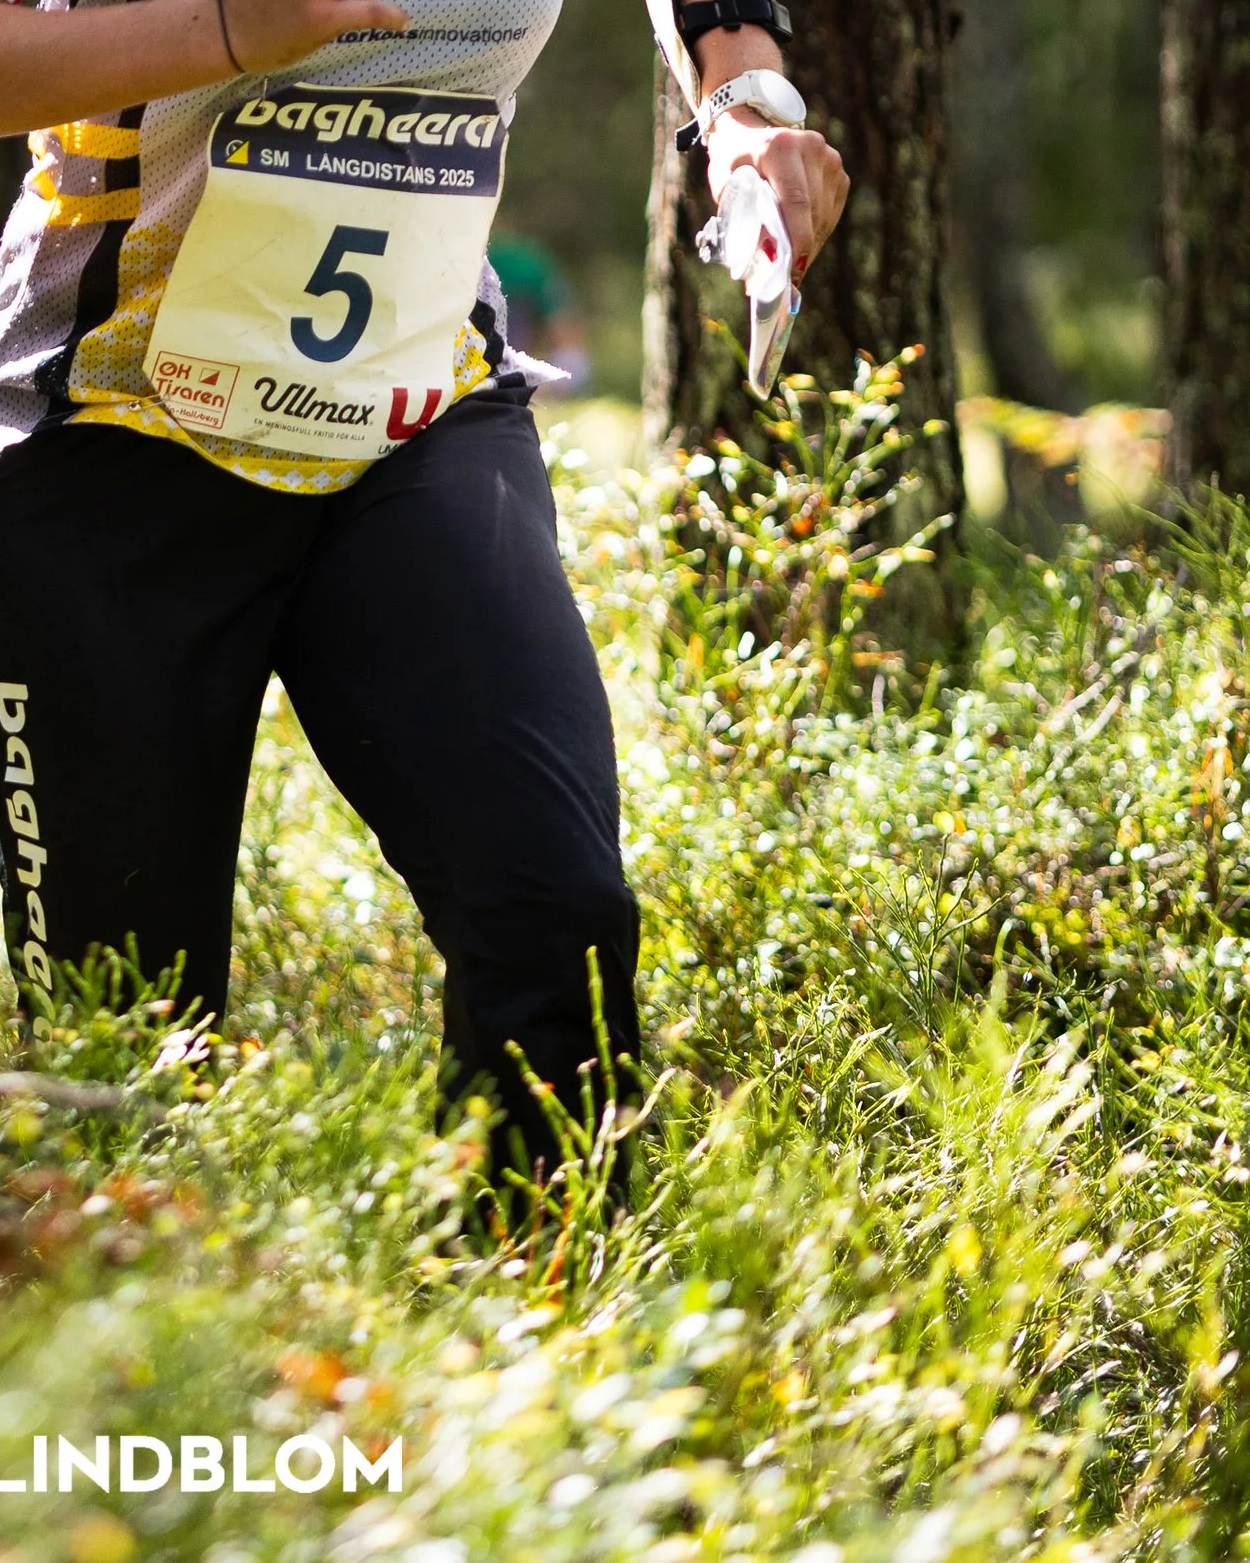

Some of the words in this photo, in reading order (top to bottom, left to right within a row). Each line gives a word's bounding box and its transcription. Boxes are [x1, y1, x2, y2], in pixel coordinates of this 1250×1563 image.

[235, 98, 501, 148] bagheera
[260, 149, 290, 168] SM
[306, 152, 435, 186] LÅNGDISTANS
[440, 168, 475, 187] 2025
[290, 224, 390, 363] 5
[253, 418, 264, 426] EN
[254, 376, 376, 426] Ullmax
